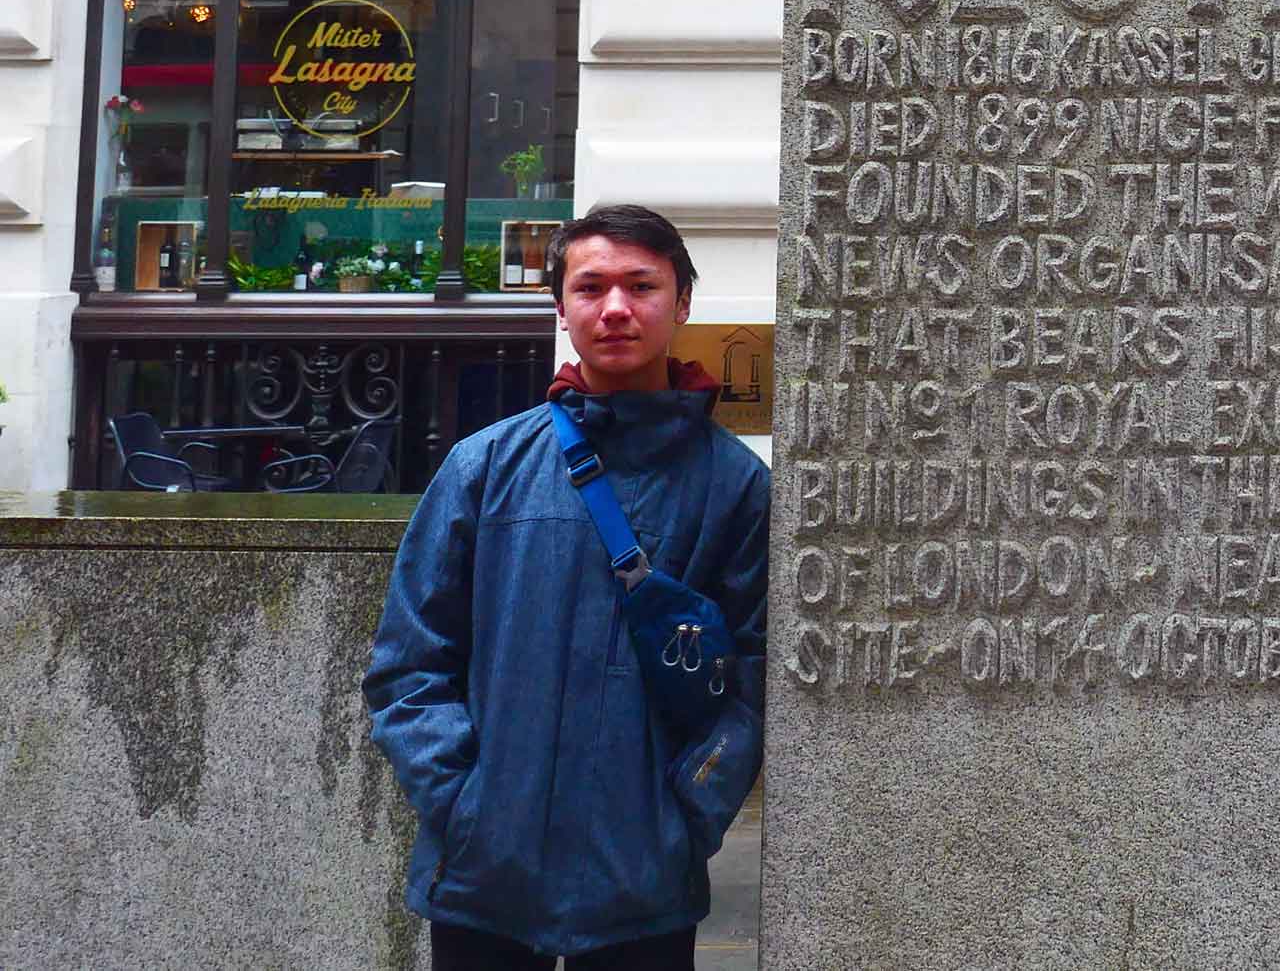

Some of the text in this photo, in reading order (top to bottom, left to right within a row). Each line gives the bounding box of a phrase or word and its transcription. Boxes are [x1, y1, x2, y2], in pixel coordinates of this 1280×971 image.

[269, 44, 416, 91] Lasagna
[307, 21, 382, 48] Mister
[801, 28, 940, 87] BORN
[945, 23, 1044, 86] 1816
[323, 91, 358, 114] City
[802, 96, 939, 160] DIED
[952, 92, 1091, 160] 1899
[802, 160, 1095, 228] FOUNDED
[1106, 162, 1238, 228] THE
[797, 232, 977, 298] NEWS
[792, 306, 978, 374] THAT
[988, 304, 1194, 374] BEARS
[788, 380, 850, 450] IN
[1004, 380, 1192, 452] ROYAL
[796, 459, 1111, 529] BUILDINGS
[792, 544, 869, 610] OF
[884, 534, 1130, 610] LONDON
